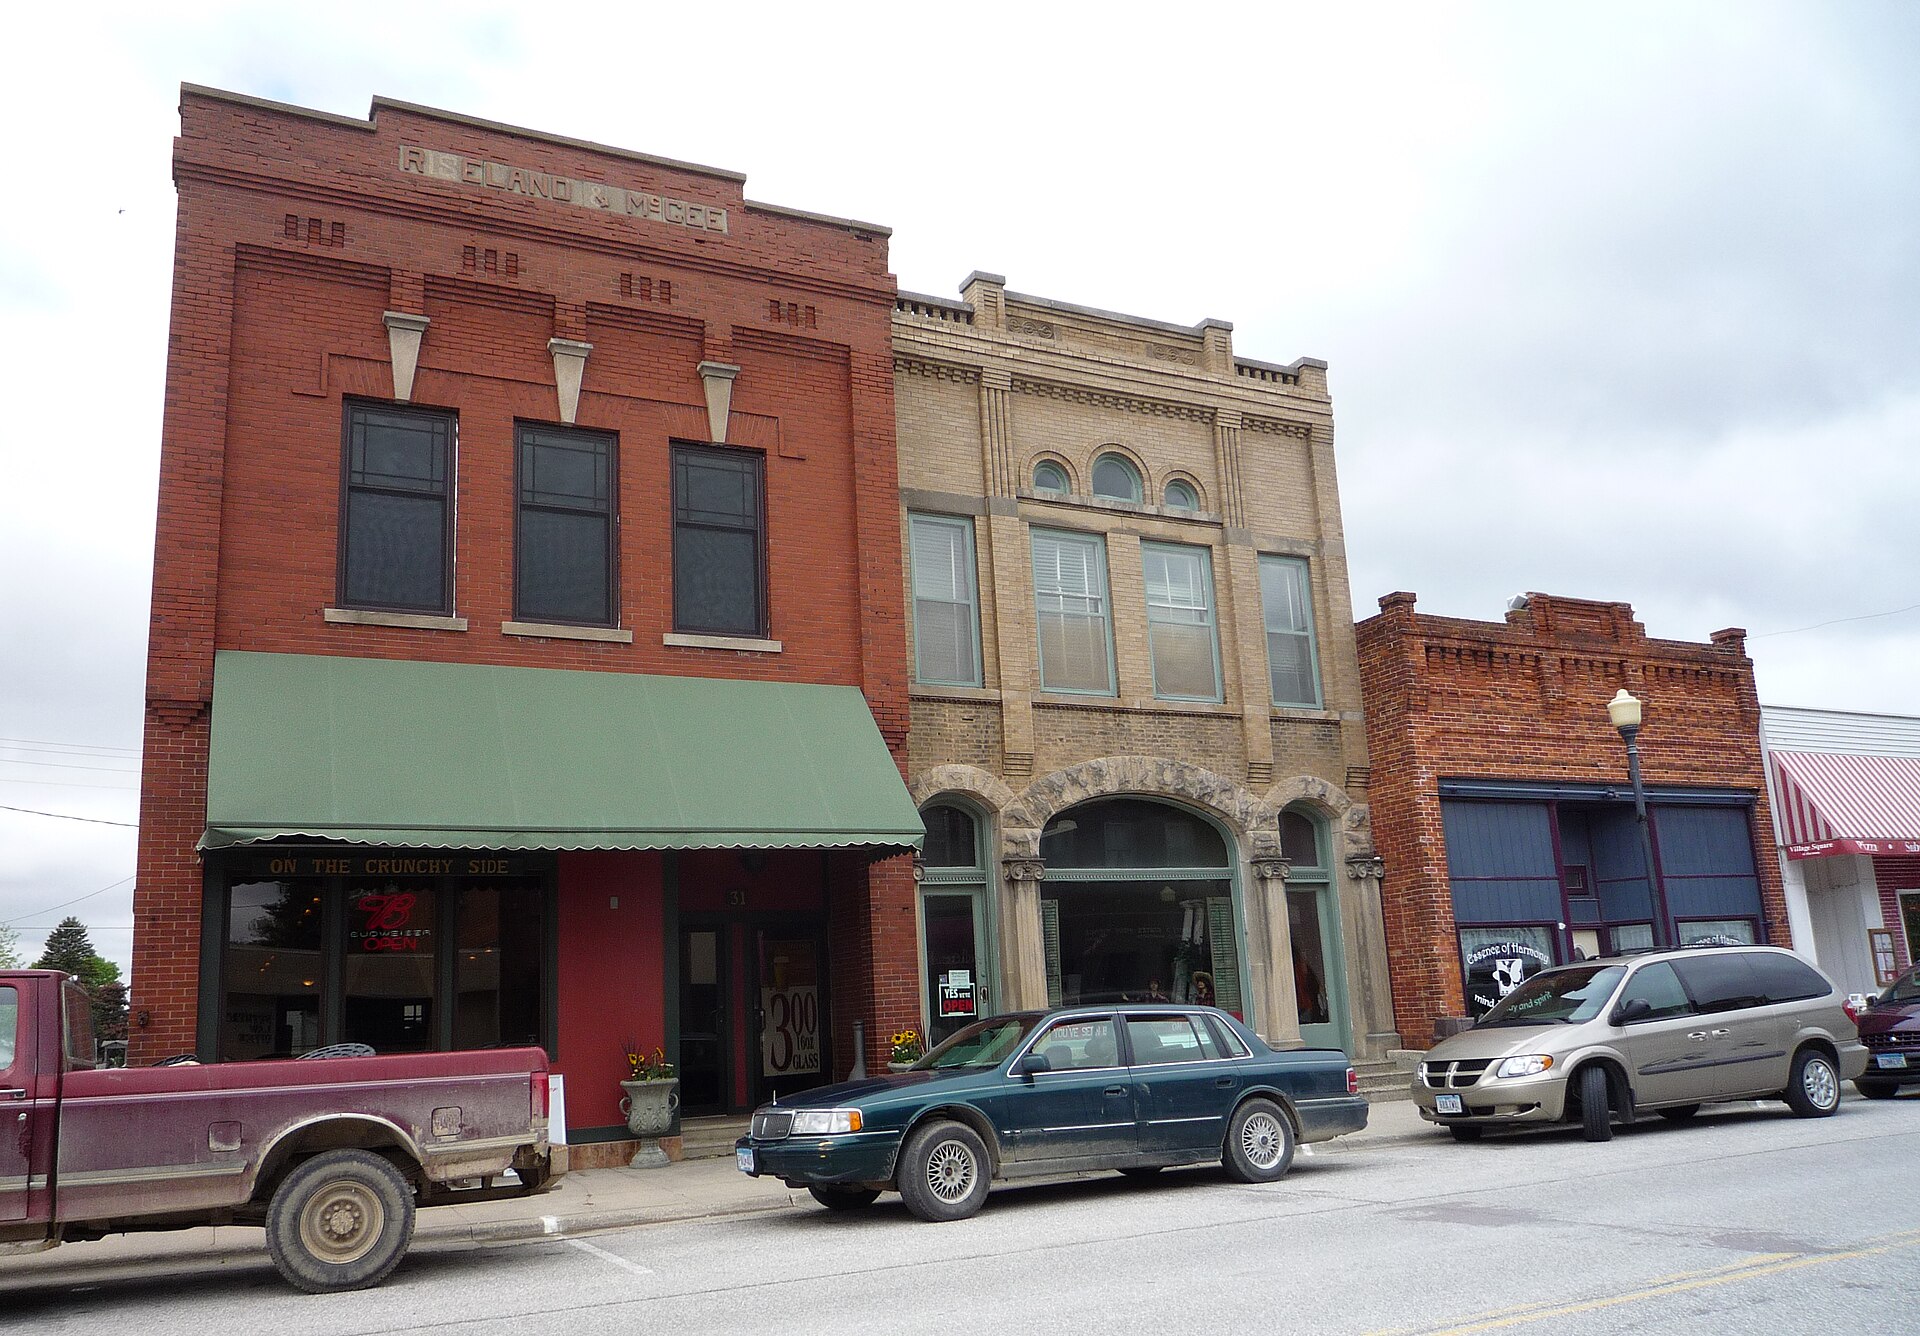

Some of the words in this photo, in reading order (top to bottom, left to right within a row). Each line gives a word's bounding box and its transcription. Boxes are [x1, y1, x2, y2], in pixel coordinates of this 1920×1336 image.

[403, 147, 571, 201] RISELAND
[592, 184, 609, 208] &
[1811, 842, 1834, 851] Square
[269, 858, 297, 874] ON
[312, 858, 351, 874] THE
[365, 858, 453, 874] CRUNCHY
[468, 858, 509, 874] SIDE
[350, 929, 432, 938] BUDWEISER
[362, 937, 418, 951] OPEN
[1466, 945, 1501, 964] Essence
[1501, 942, 1510, 955] of
[1511, 942, 1550, 965] Harmony
[944, 988, 959, 999] YES
[1533, 991, 1553, 1006] spirit
[943, 998, 974, 1013] OPEN
[793, 1053, 819, 1070] GLASS
